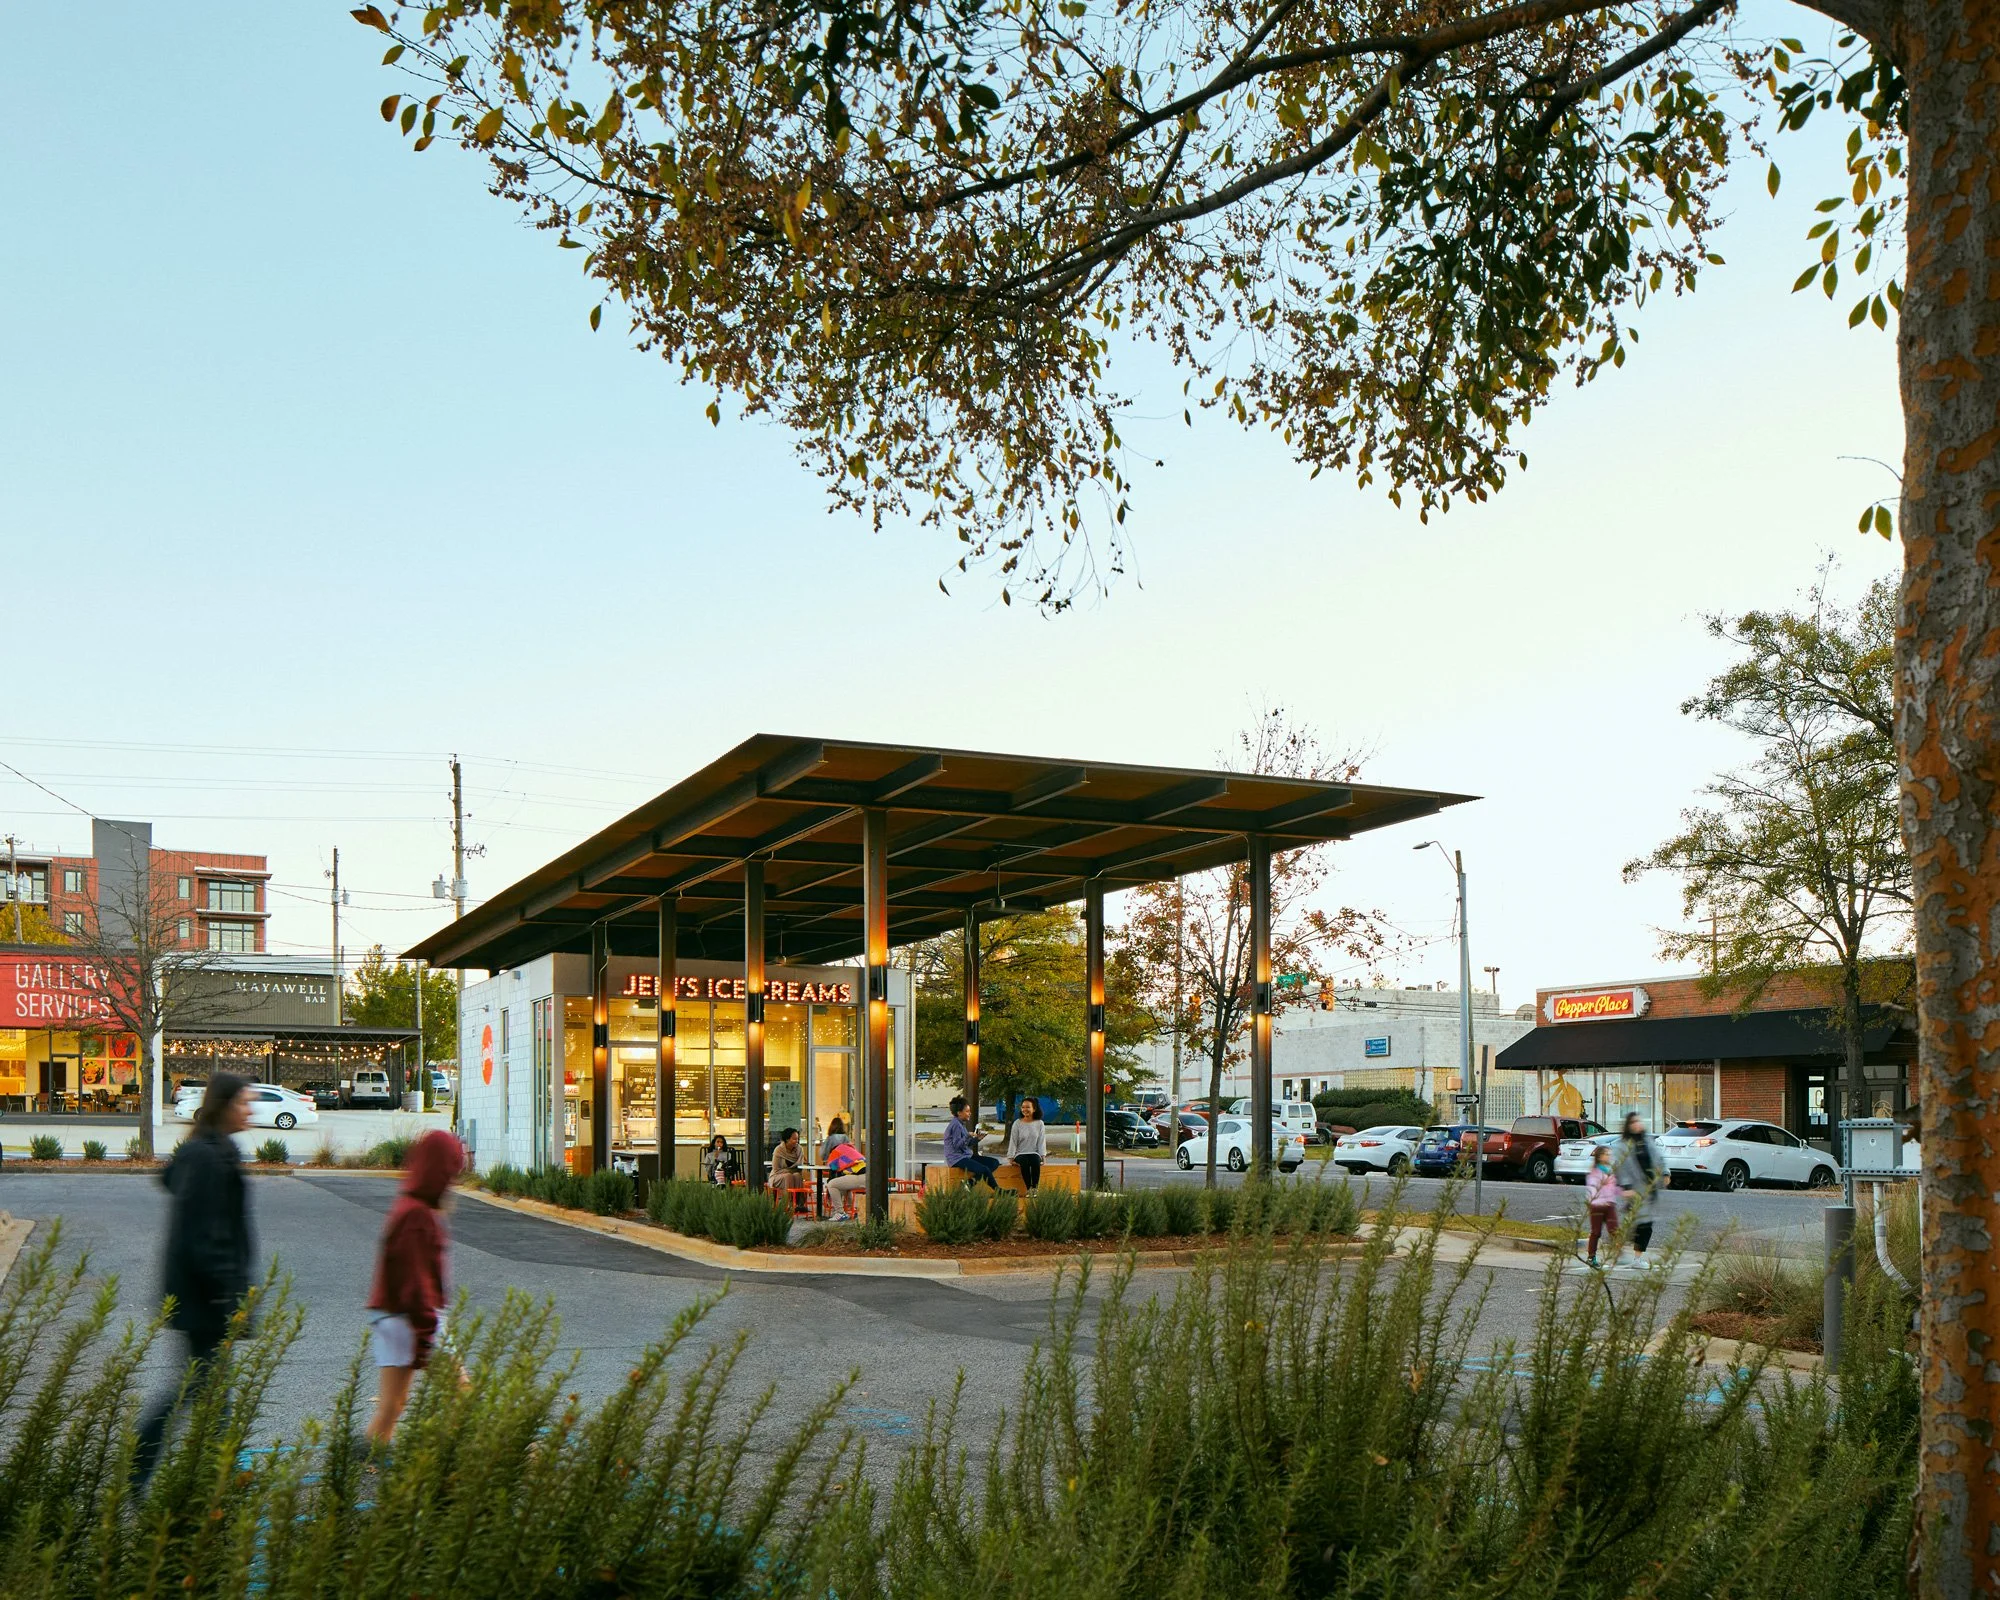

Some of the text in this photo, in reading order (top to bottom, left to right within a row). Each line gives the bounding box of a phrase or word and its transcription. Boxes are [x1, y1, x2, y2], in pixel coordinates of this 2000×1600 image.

[16, 964, 109, 989] GALLERY
[235, 982, 327, 994] MAYAWELL
[707, 978, 746, 999] ICE
[16, 993, 110, 1019] SERVICES
[1556, 996, 1628, 1018] Pepper Place
